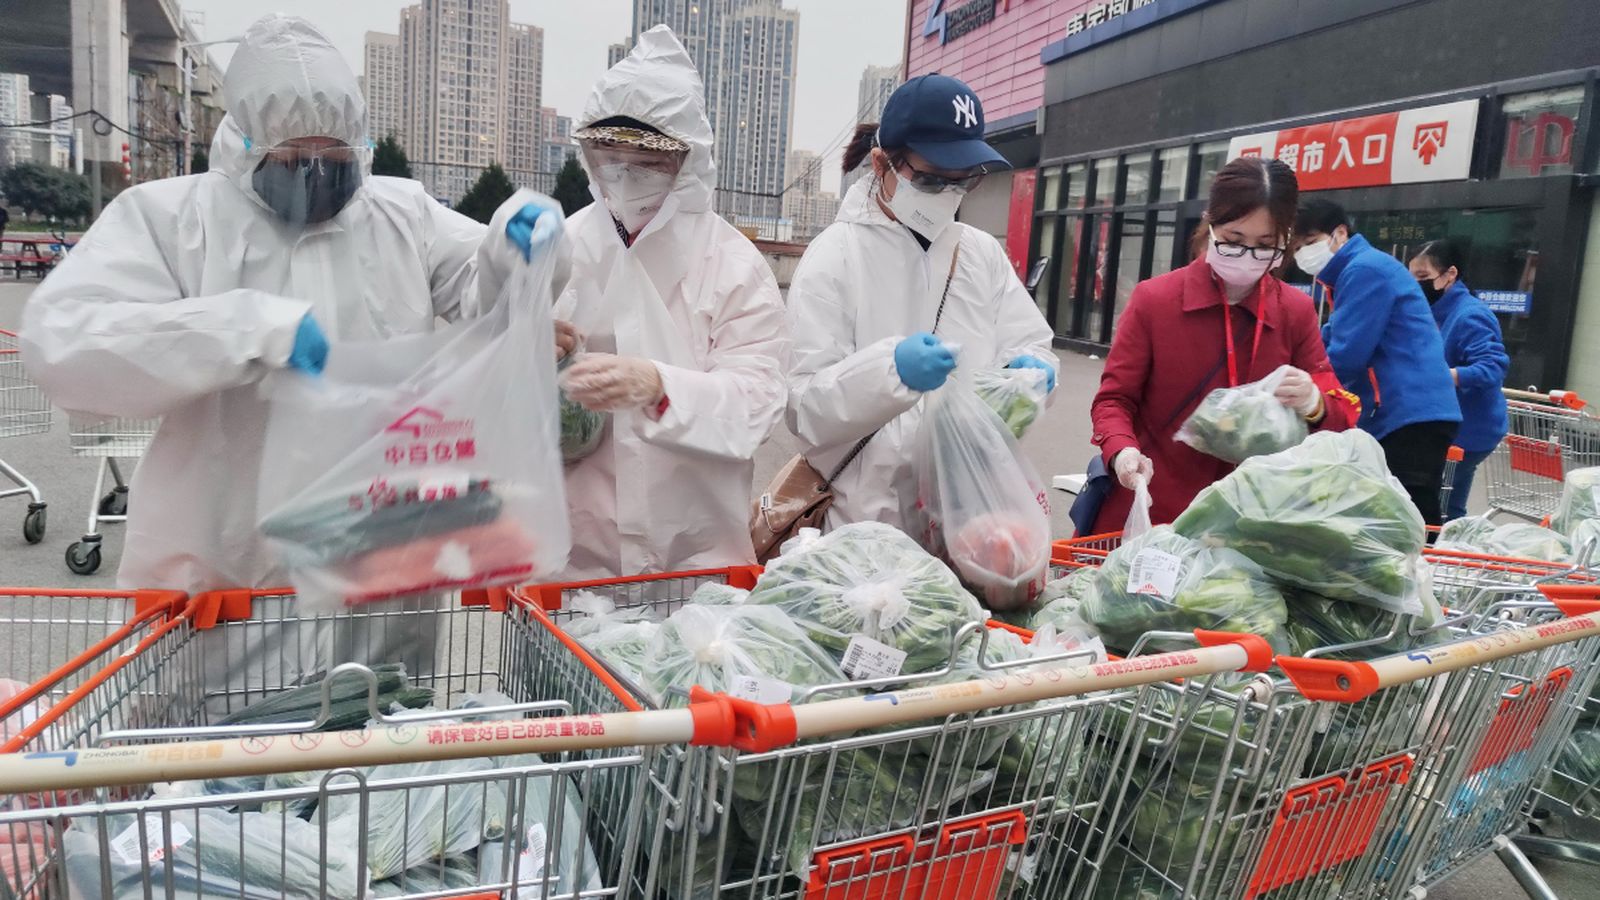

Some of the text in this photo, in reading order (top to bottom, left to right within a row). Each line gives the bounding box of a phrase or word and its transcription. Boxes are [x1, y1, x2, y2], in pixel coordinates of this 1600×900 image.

[952, 94, 978, 128] NY
[1279, 133, 1388, 173] 超市入口
[426, 721, 605, 745] 请保管好自己的贵重物品
[83, 750, 139, 760] ZHONGBAI
